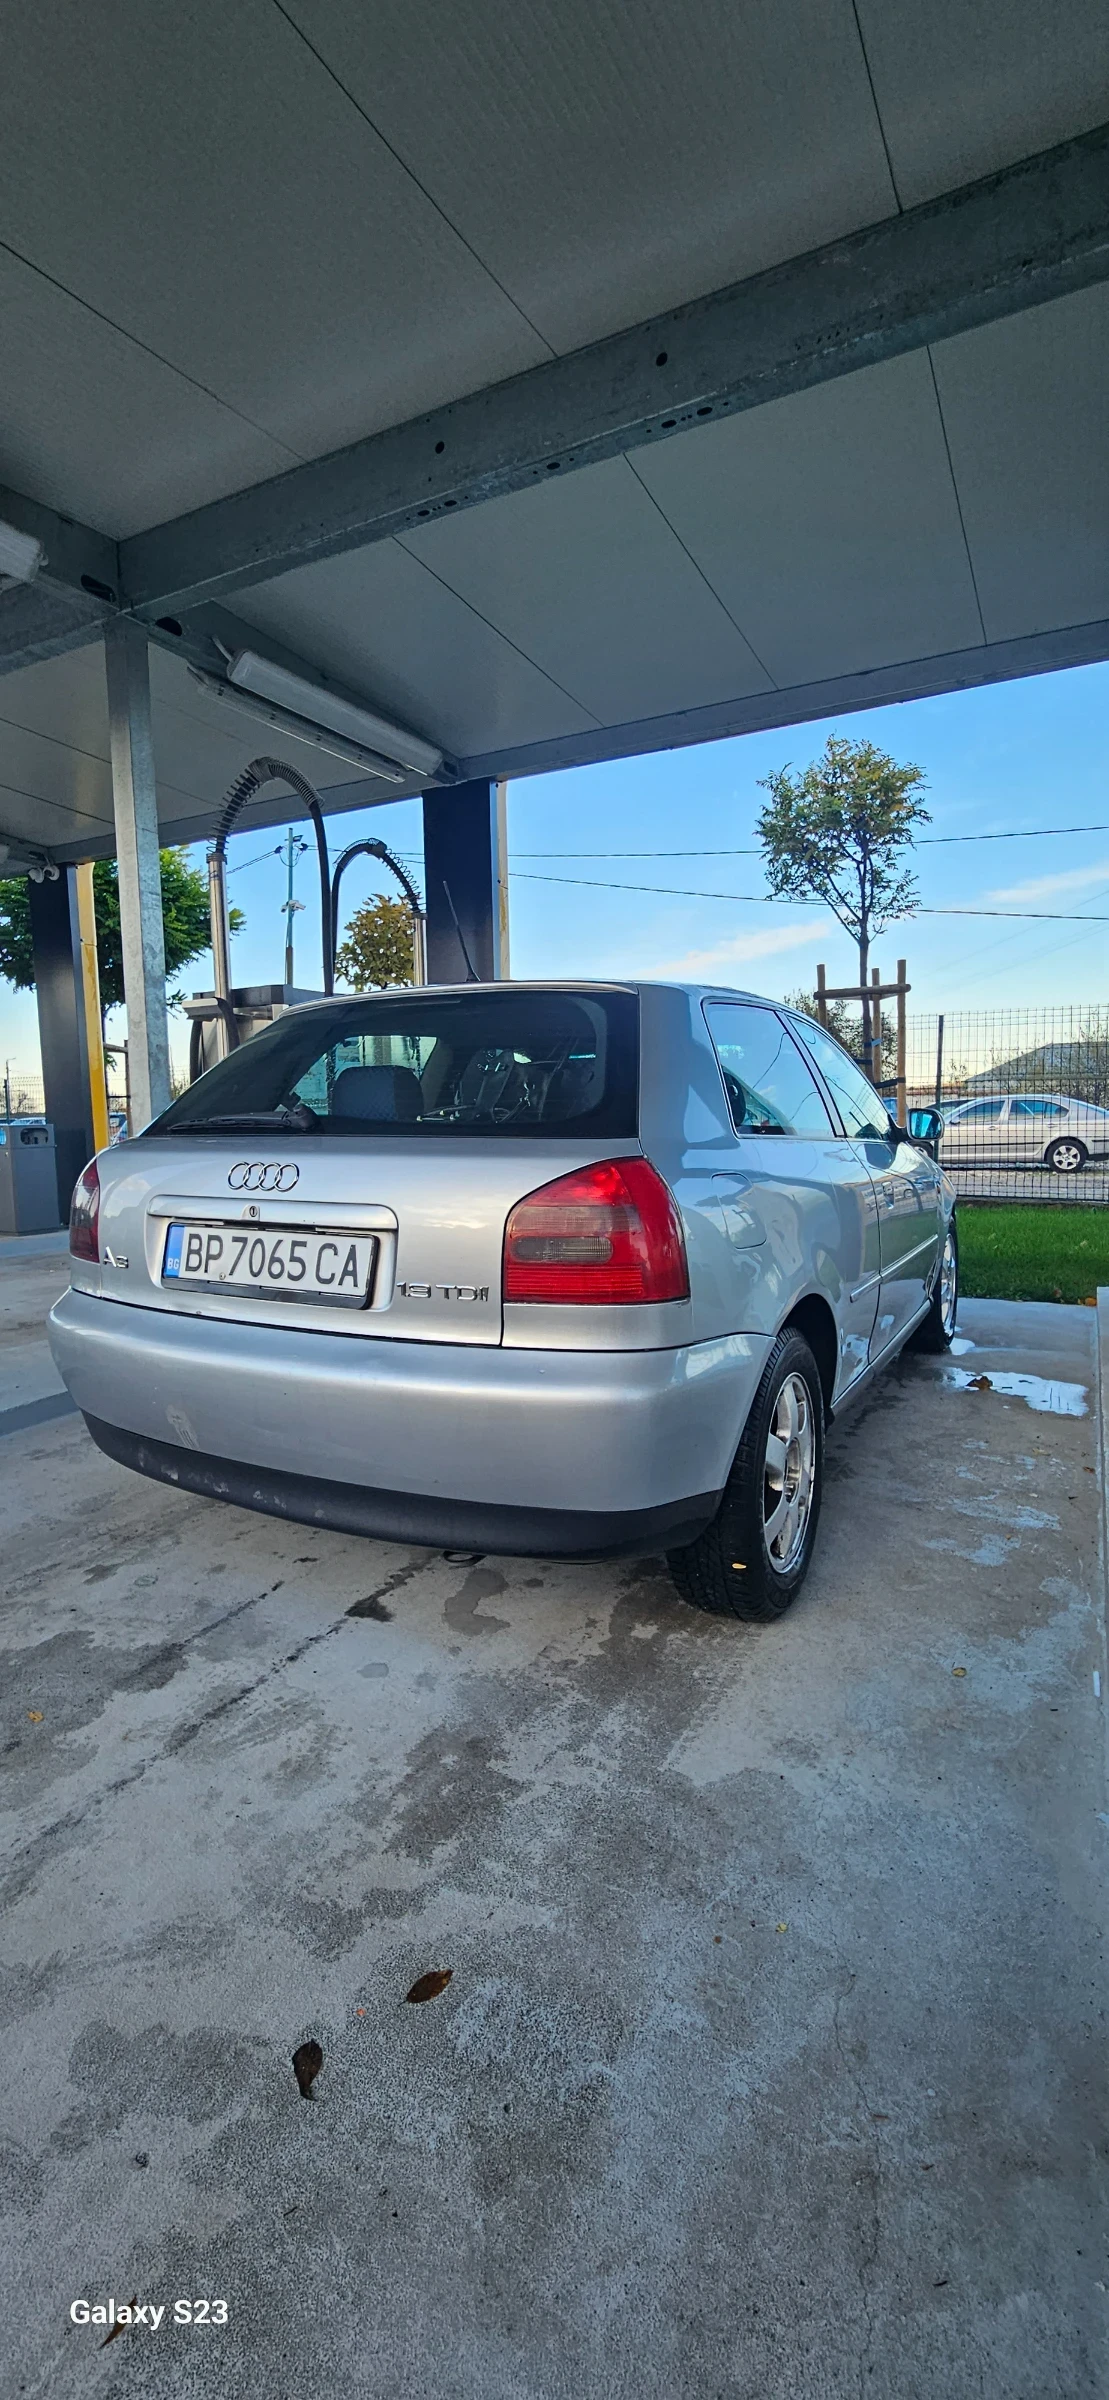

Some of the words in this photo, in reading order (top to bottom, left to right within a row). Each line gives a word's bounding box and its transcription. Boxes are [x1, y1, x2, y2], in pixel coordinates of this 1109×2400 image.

[167, 1257, 180, 1270] BG
[185, 1233, 224, 1274] BP
[228, 1235, 308, 1282] 7065
[315, 1242, 359, 1288] CA
[435, 1285, 490, 1302] TDI
